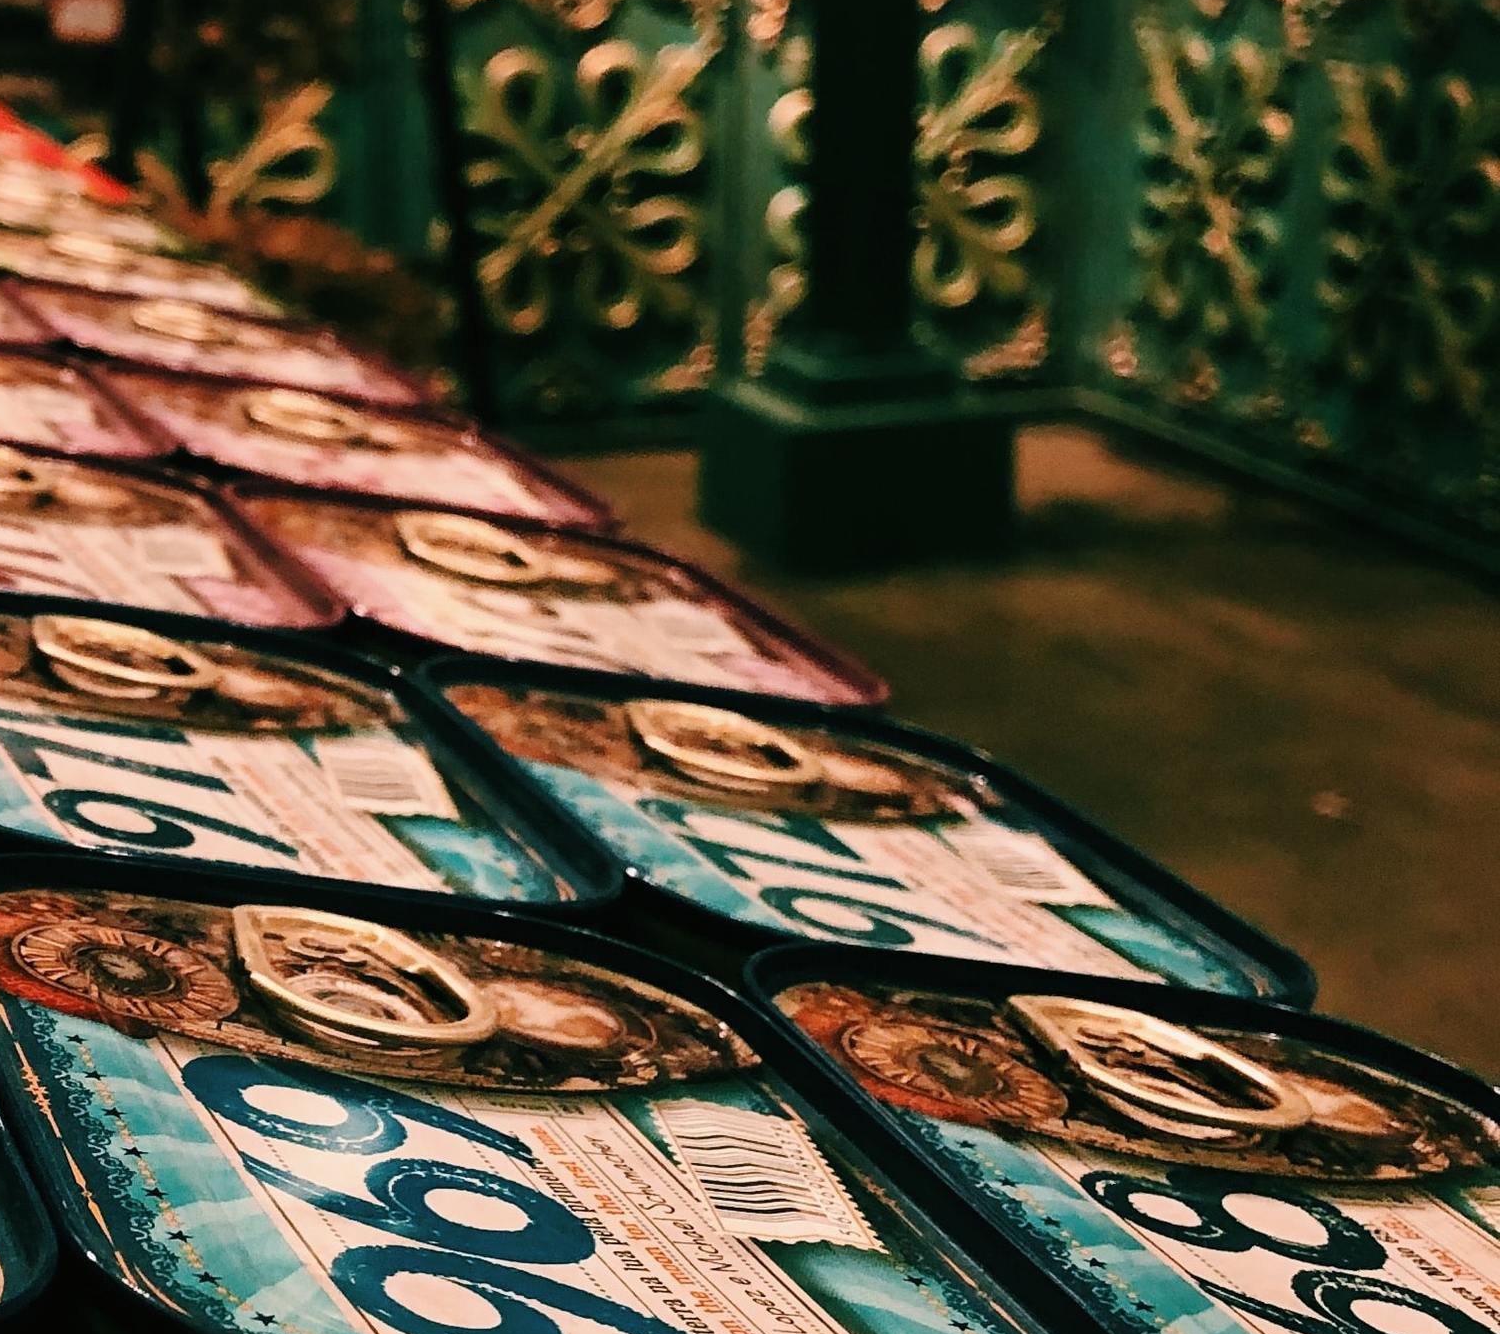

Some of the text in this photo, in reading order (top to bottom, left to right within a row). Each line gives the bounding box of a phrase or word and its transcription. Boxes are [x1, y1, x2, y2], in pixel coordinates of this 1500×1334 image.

[636, 795, 1010, 951] 972
[557, 1160, 600, 1189] first
[584, 1134, 676, 1215] Schumacher
[595, 1193, 625, 1214] the
[581, 1216, 630, 1247] pela
[620, 1220, 650, 1241] for
[653, 1217, 739, 1273] Michael
[613, 1251, 650, 1273] lua
[646, 1246, 695, 1286] moon
[640, 1276, 674, 1295] na
[728, 1276, 752, 1286] e
[690, 1290, 724, 1314] the
[745, 1289, 806, 1334] Lopez
